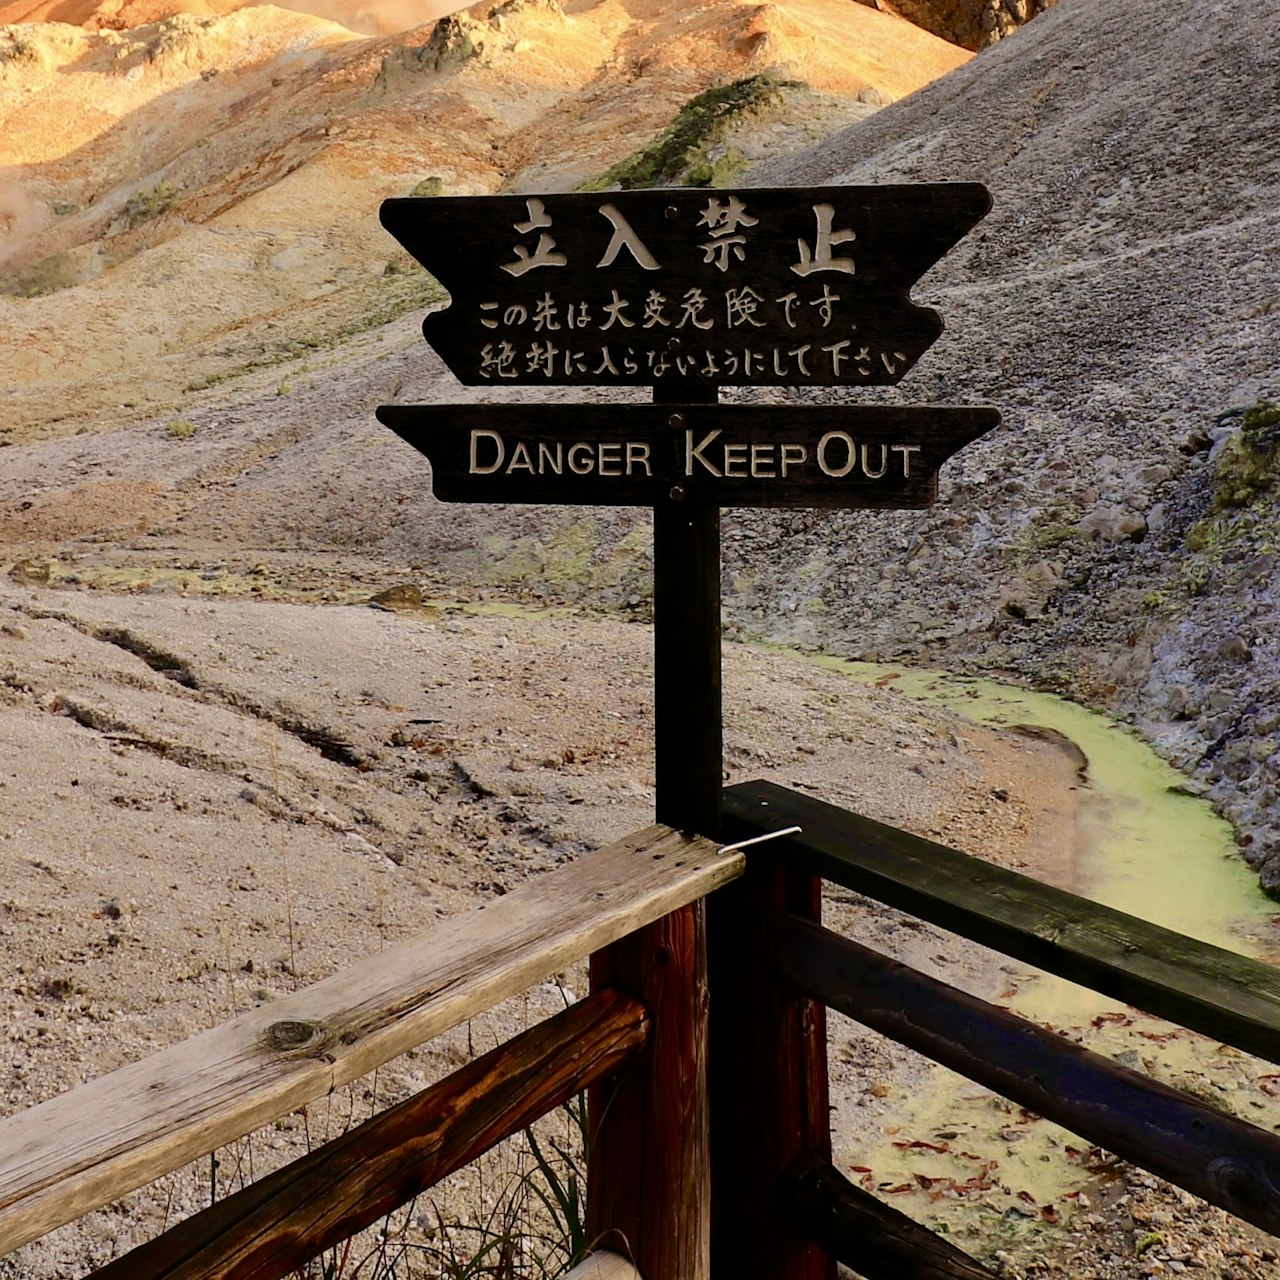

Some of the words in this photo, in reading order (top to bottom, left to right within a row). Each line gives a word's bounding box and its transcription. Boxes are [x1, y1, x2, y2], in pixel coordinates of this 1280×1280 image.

[500, 194, 856, 278] 立入禁止
[479, 339, 907, 378] 絶対に入らないようにして下さい
